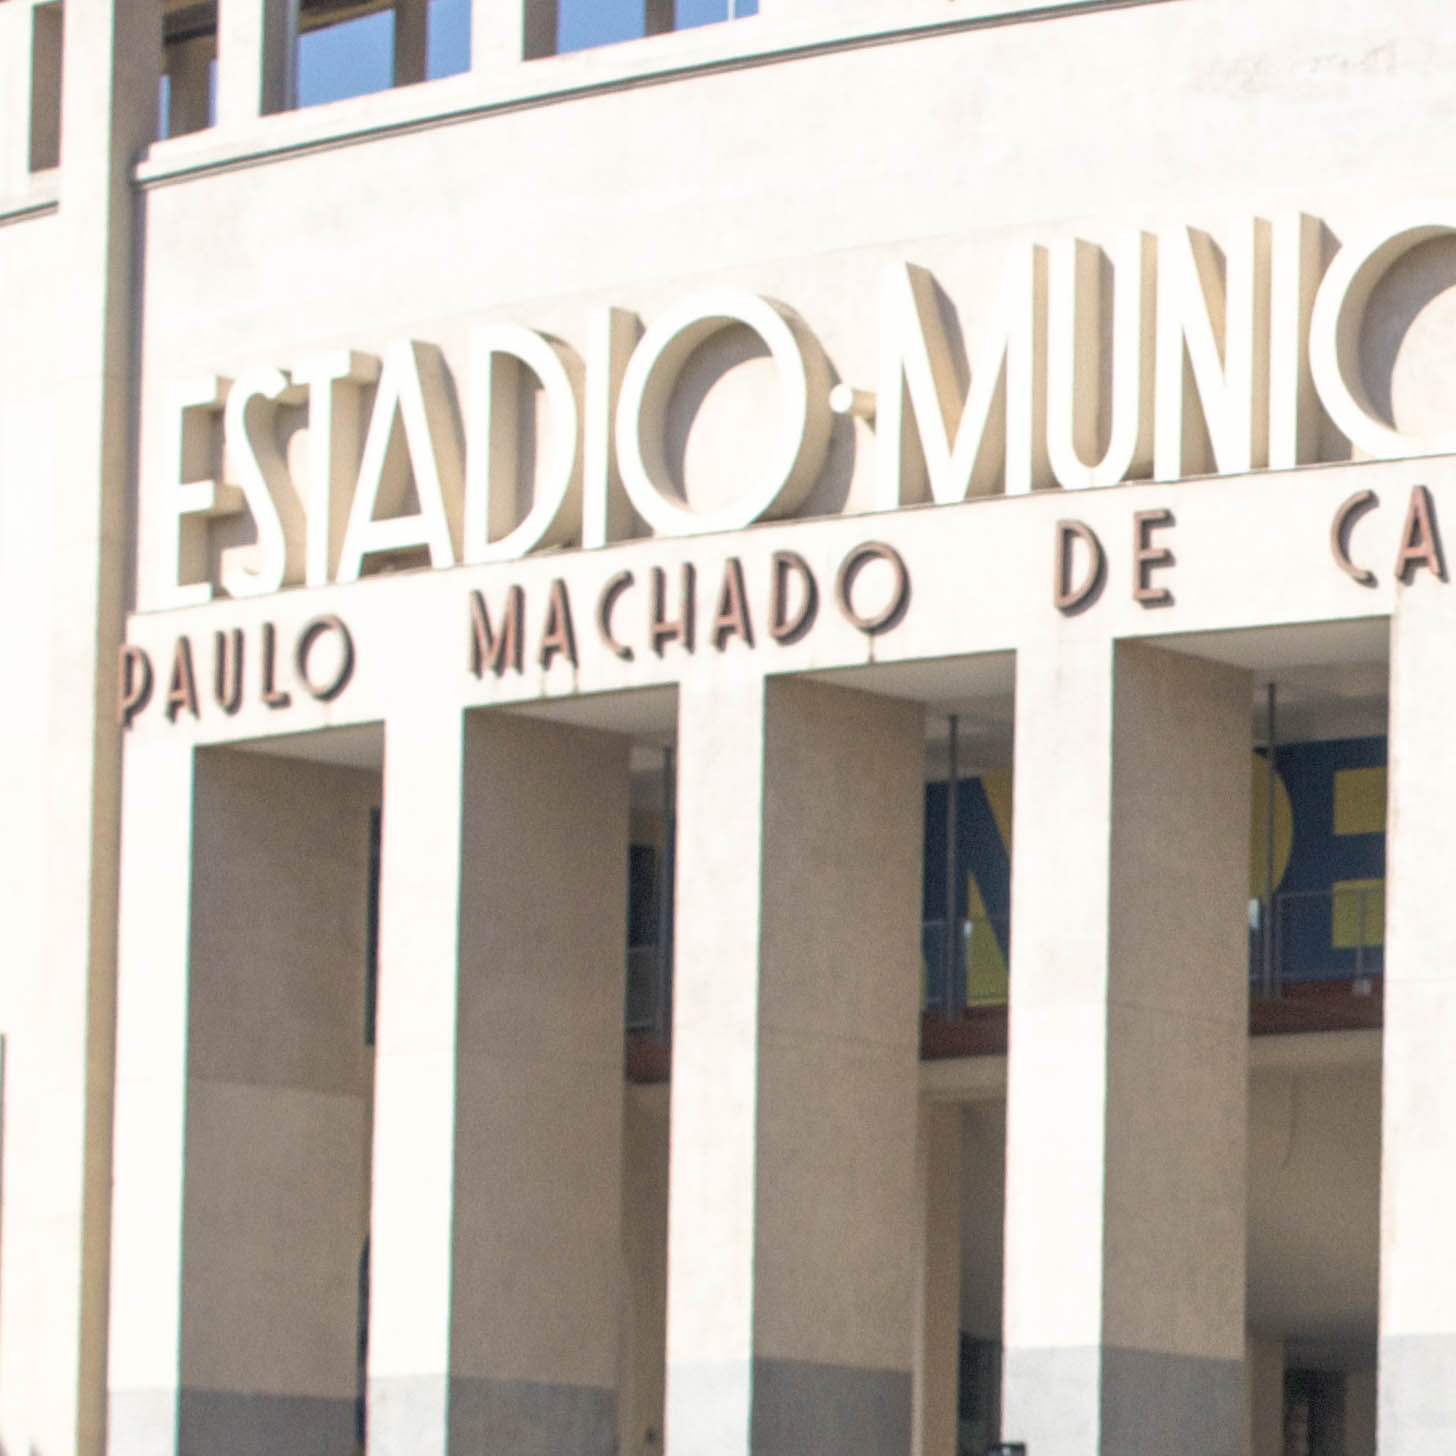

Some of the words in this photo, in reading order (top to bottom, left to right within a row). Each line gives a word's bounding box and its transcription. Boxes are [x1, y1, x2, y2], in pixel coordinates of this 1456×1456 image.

[158, 285, 810, 601] ESTADIO
[116, 613, 357, 728] PAULO
[468, 540, 913, 681] MACHADO
[1053, 507, 1175, 617] DE
